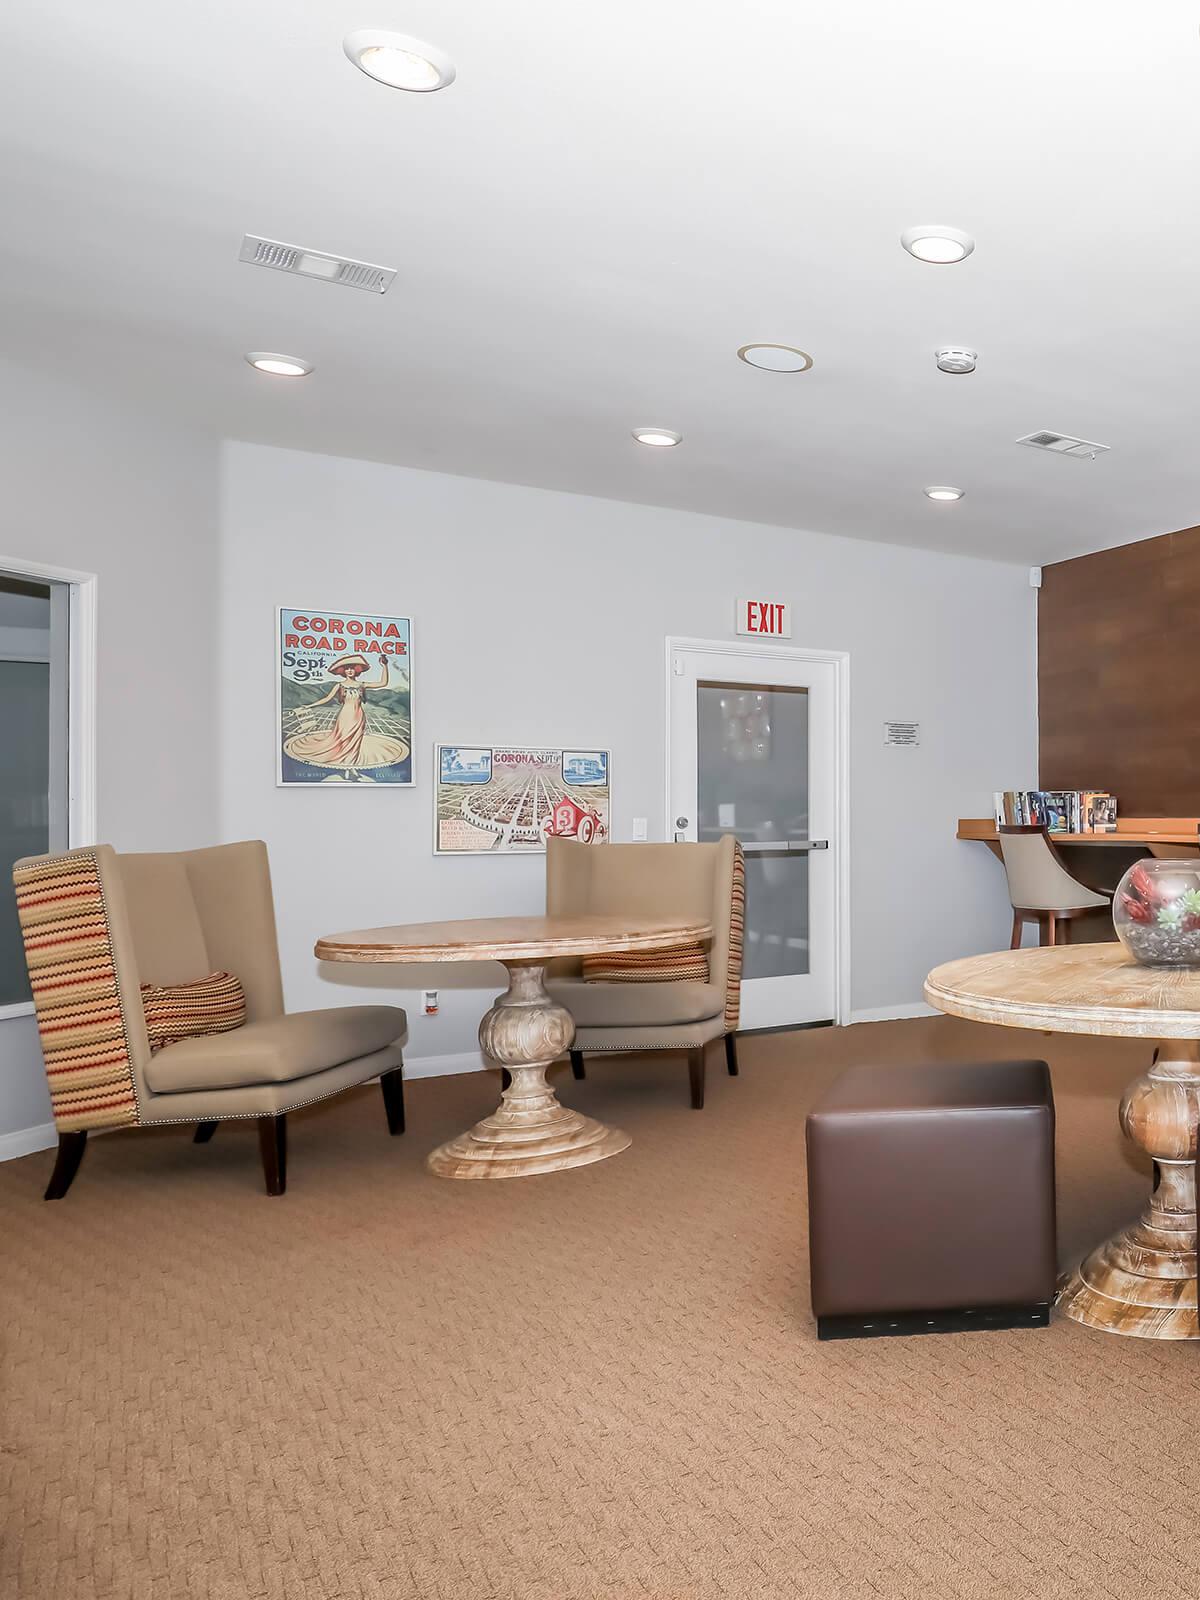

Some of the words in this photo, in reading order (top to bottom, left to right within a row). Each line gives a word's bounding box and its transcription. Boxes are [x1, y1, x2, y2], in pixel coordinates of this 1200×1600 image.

[292, 615, 401, 638] CORONA
[747, 601, 785, 634] EXIT
[285, 634, 347, 651] ROAD
[353, 638, 407, 656] RACE
[283, 651, 328, 672] Sept.
[293, 669, 324, 682] 9th
[559, 809, 571, 827] 3
